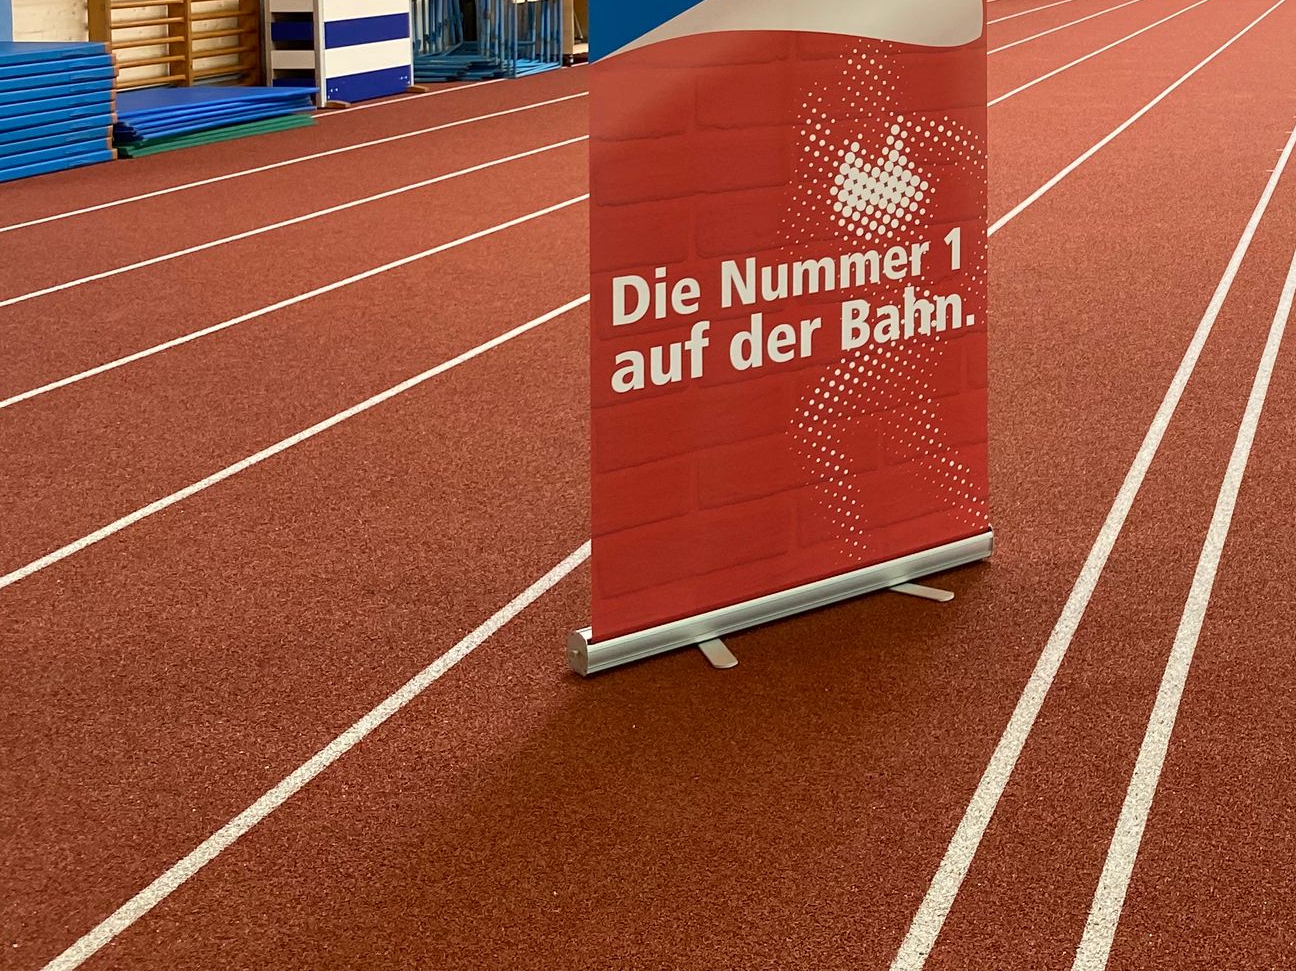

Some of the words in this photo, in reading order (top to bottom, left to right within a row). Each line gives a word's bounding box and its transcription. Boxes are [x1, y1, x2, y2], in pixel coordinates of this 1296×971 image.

[612, 267, 700, 326] Die
[721, 241, 929, 308] Nummer
[944, 227, 961, 271] 1
[611, 321, 710, 393] auf
[729, 313, 822, 371] der
[841, 286, 975, 350] Bahn.
